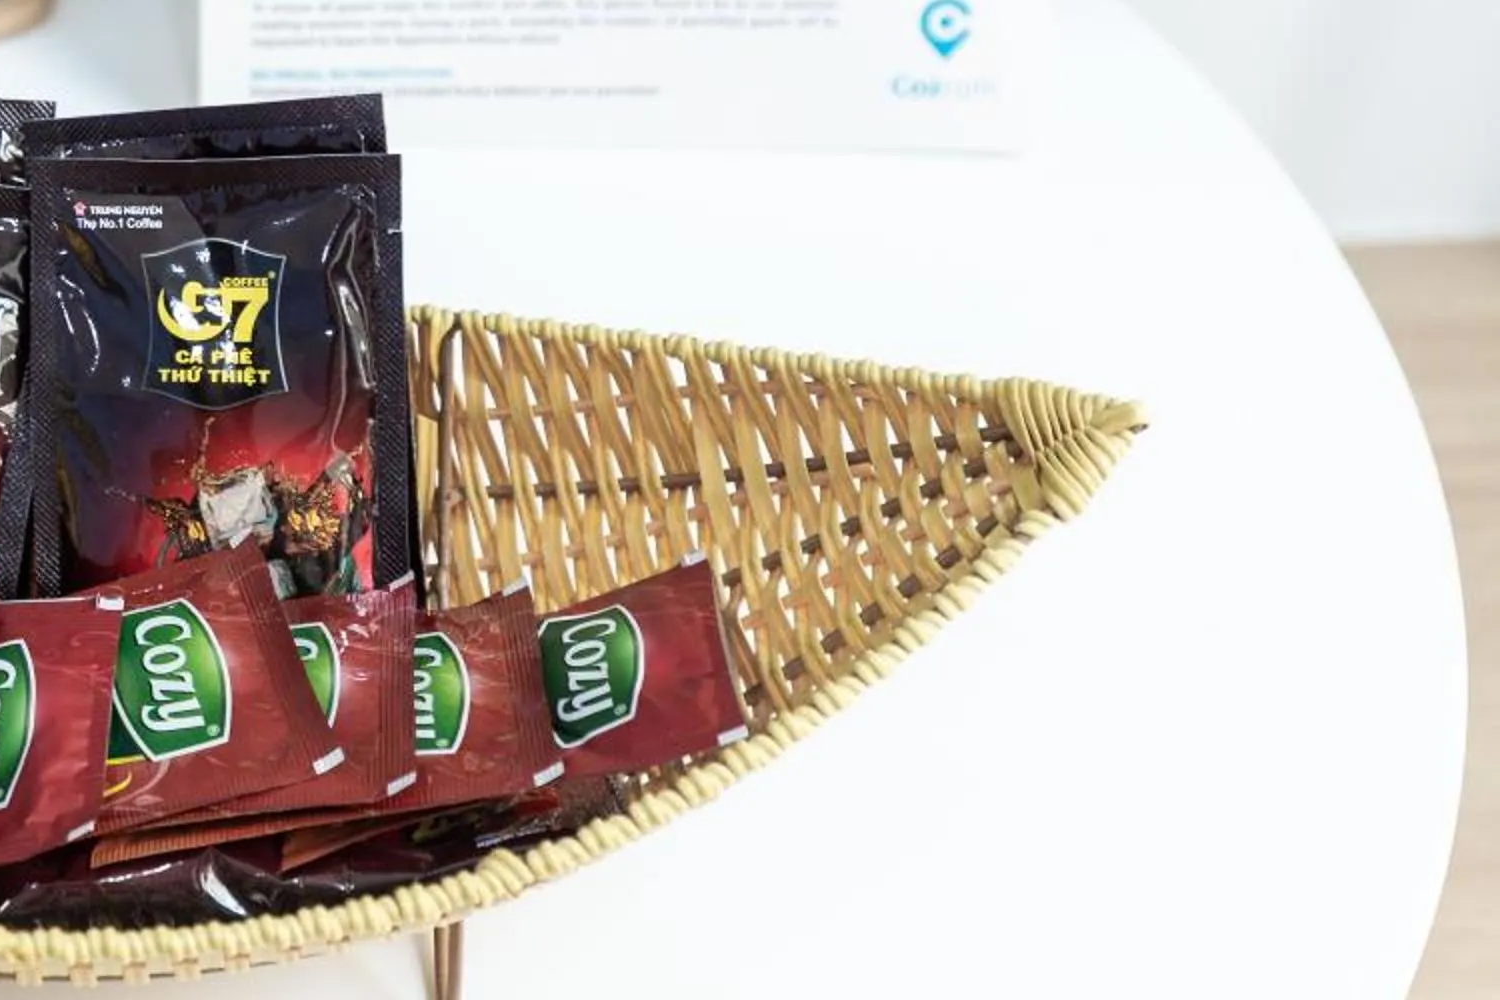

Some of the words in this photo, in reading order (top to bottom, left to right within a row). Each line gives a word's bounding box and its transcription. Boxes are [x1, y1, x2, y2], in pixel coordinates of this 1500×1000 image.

[90, 205, 122, 215] TRUNG
[126, 217, 163, 229] Coffee
[222, 277, 269, 288] COFFEE
[157, 280, 269, 343] G7
[207, 366, 271, 387] THIỆT
[135, 615, 206, 731] Cozy
[557, 618, 617, 722] Cozy
